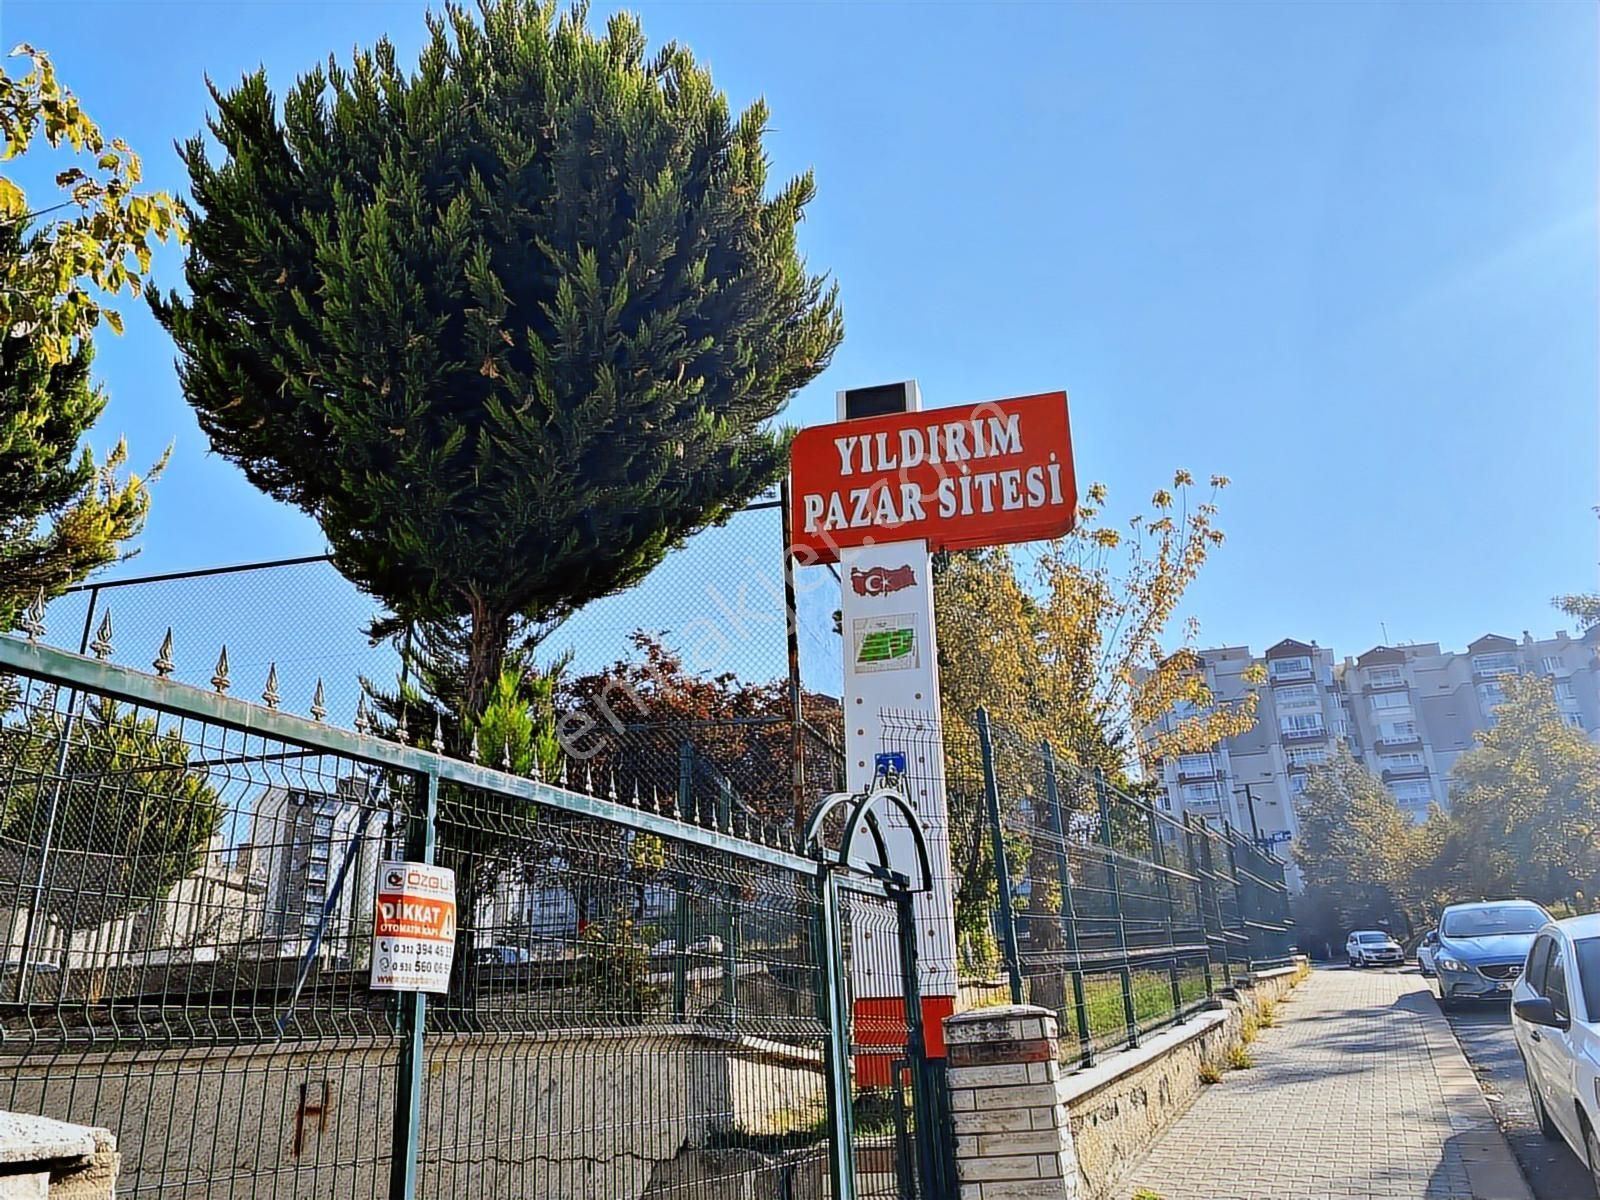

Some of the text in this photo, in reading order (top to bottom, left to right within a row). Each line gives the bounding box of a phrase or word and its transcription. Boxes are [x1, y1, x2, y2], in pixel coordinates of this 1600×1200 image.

[834, 414, 1024, 475] YILDIRIM
[804, 452, 1064, 533] PAZAR SİTESİ
[382, 899, 441, 924] DİKKAT
[394, 944, 399, 953] 0
[401, 944, 413, 954] 312
[416, 943, 432, 955] 394
[392, 962, 397, 971] 0
